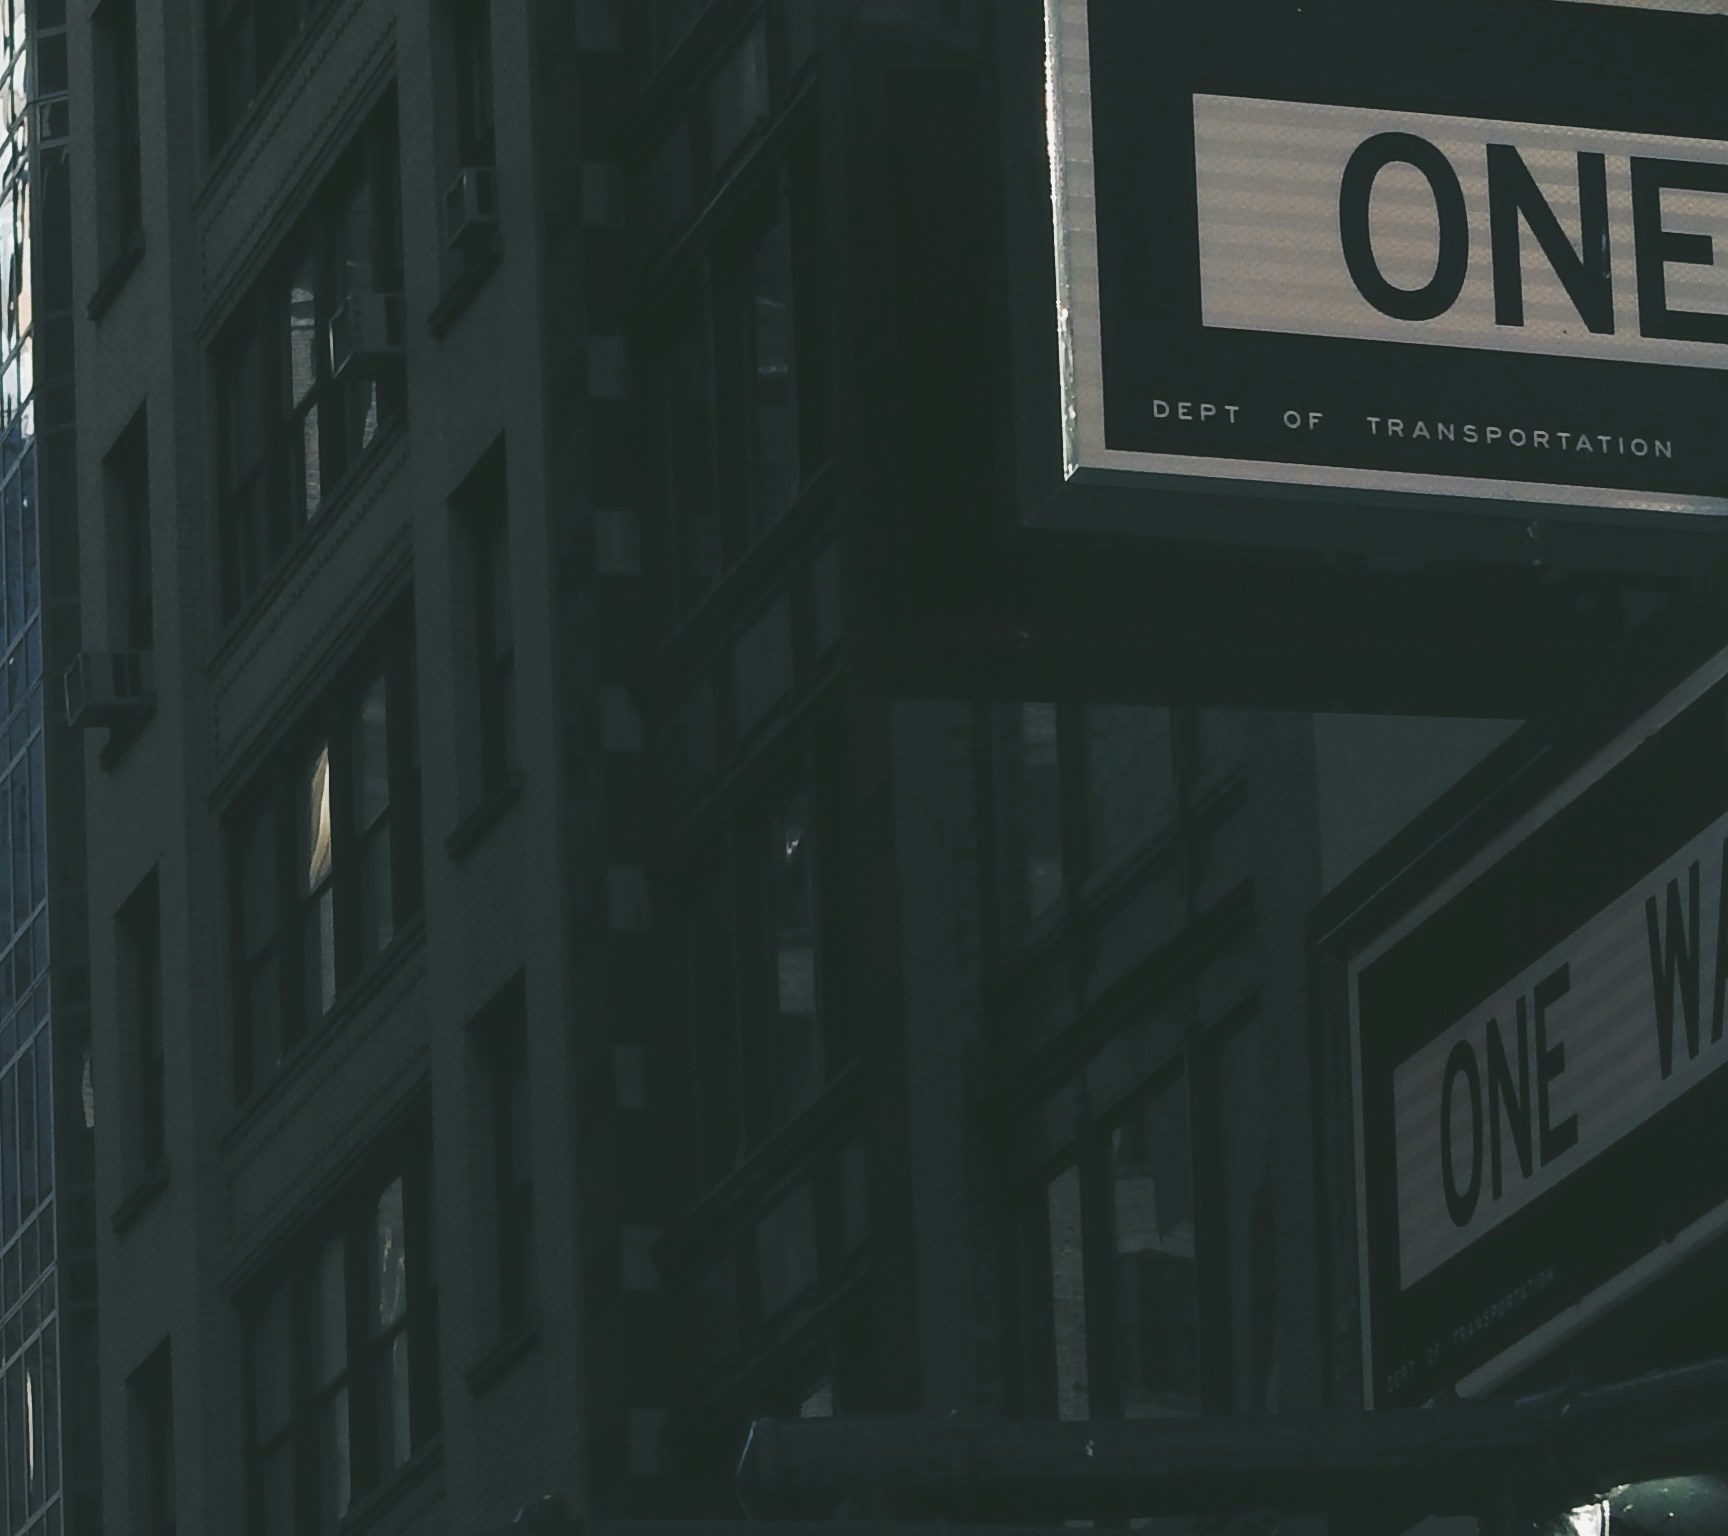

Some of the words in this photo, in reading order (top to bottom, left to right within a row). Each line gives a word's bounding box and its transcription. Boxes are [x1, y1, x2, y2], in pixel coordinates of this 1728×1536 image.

[1338, 131, 1728, 345] ONE
[1152, 398, 1242, 426] DEPT
[1282, 409, 1325, 431] OF
[1366, 415, 1675, 460] TRANSPORTATION
[1440, 961, 1579, 1228] ONE
